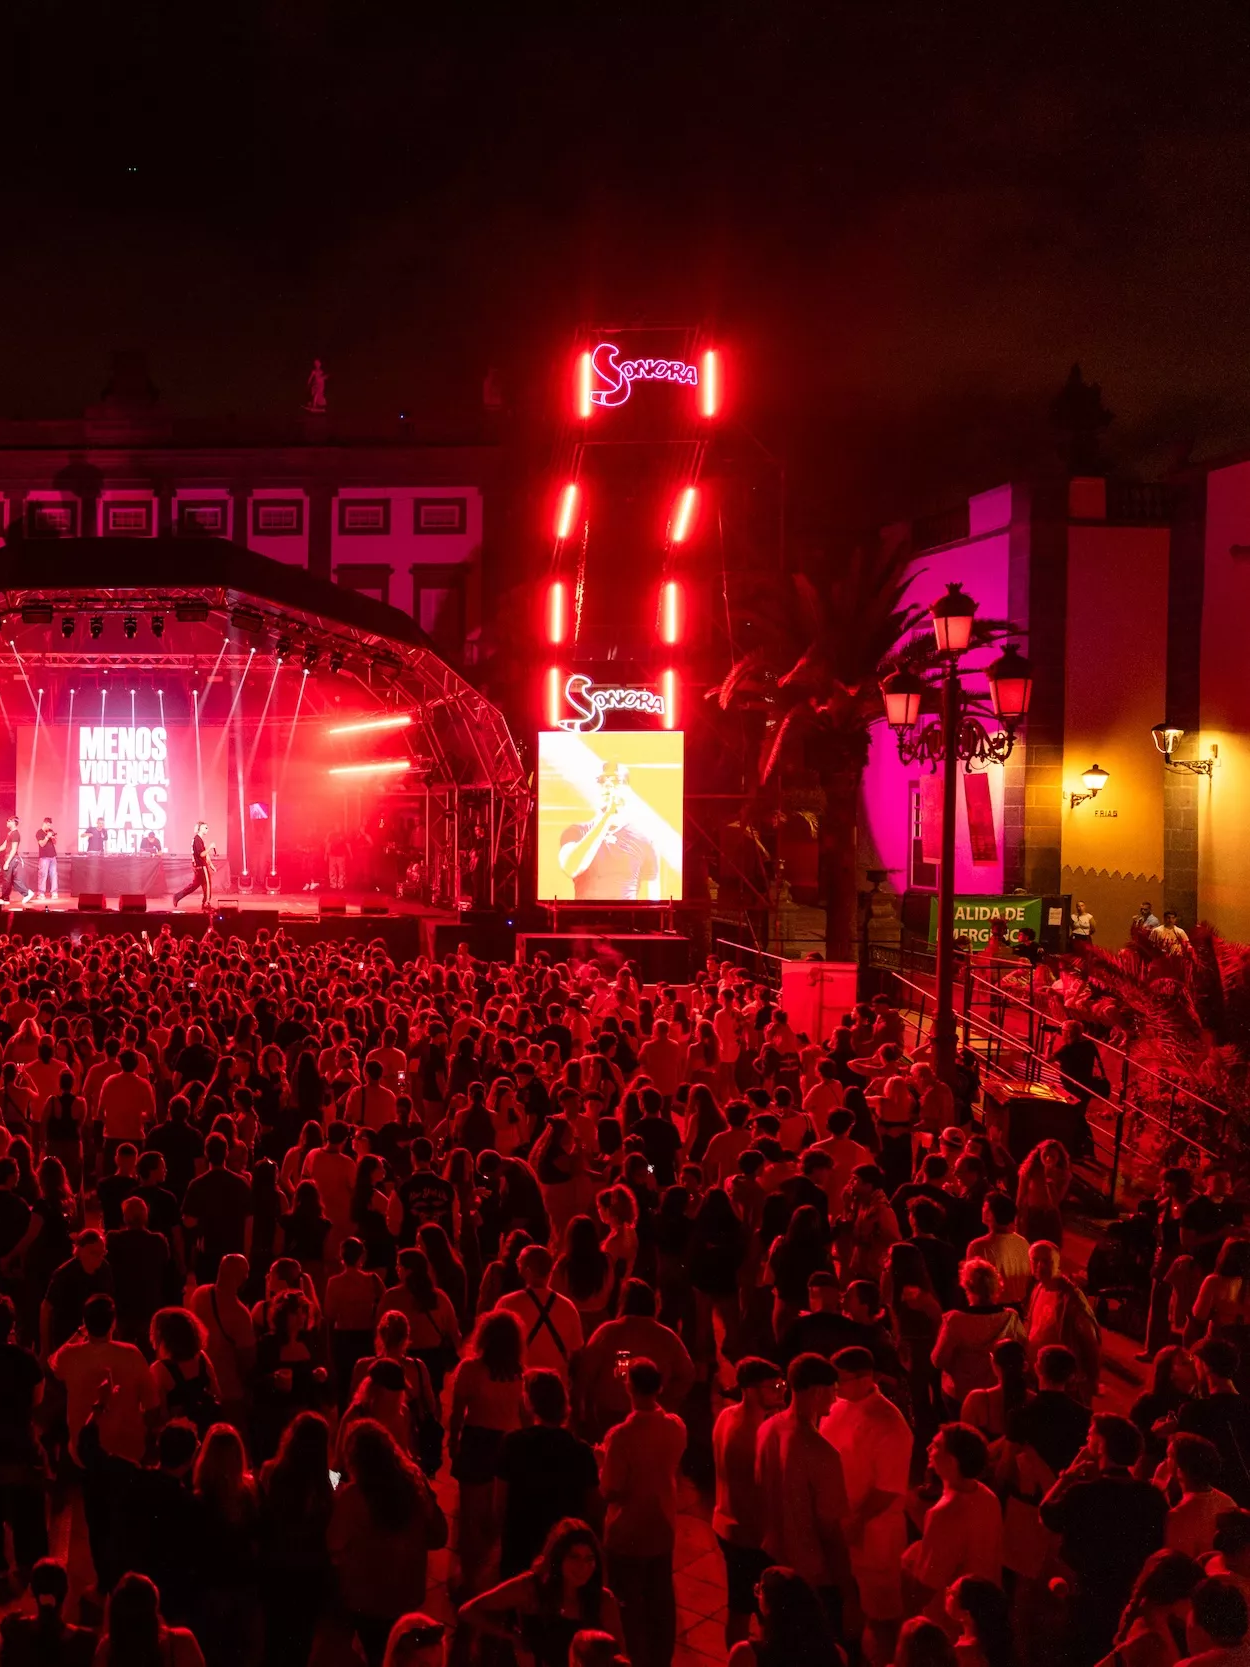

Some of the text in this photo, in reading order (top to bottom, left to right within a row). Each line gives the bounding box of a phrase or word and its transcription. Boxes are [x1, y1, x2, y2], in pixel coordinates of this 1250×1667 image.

[79, 727, 168, 761] MENOS
[78, 761, 170, 787] VIOLENCIA,
[954, 906, 1025, 920] ALIDA DE
